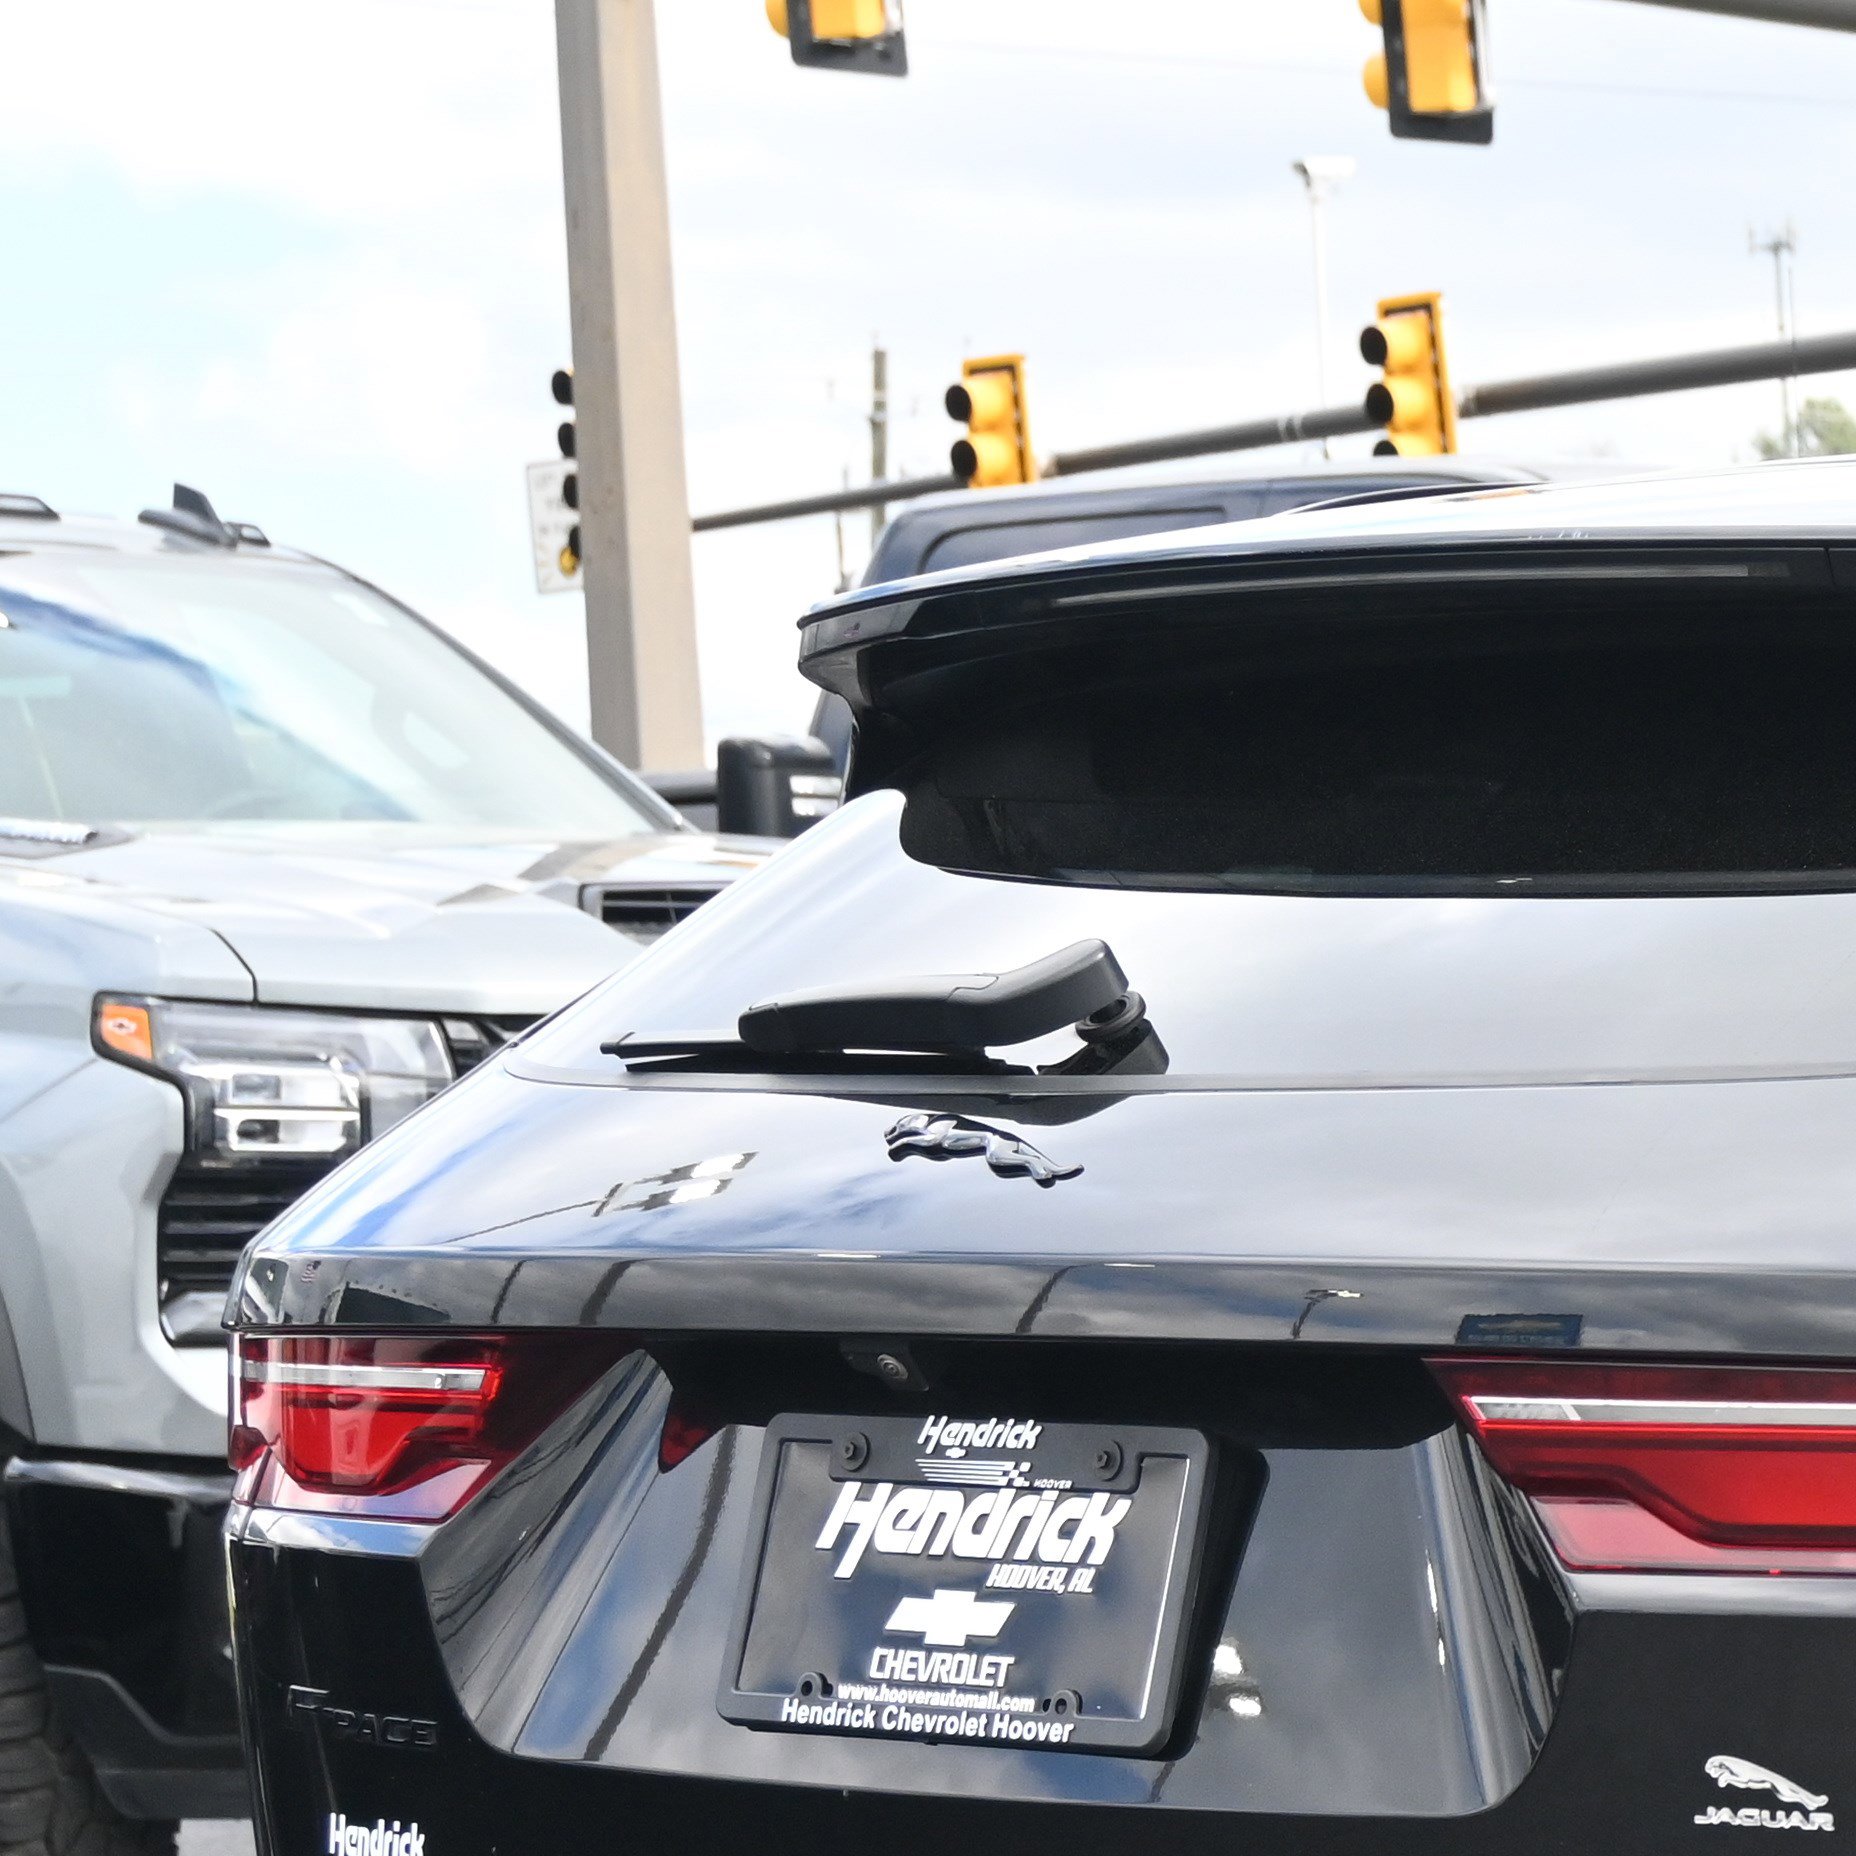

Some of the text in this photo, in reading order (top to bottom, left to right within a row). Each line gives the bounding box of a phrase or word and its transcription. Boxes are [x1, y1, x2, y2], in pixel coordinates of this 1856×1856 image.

[917, 1415, 1043, 1455] Hendrick
[1033, 1478, 1073, 1490] HOOVER
[815, 1481, 1132, 1579] Hendrick
[985, 1563, 1097, 1595] HOOVER, AL
[869, 1646, 1016, 1688] CHEVROLET
[837, 1682, 1036, 1713] www.hooverautomall.com
[780, 1697, 1075, 1743] Hendrick Chevrolet Hoover
[1693, 1806, 1835, 1832] JAGUAR
